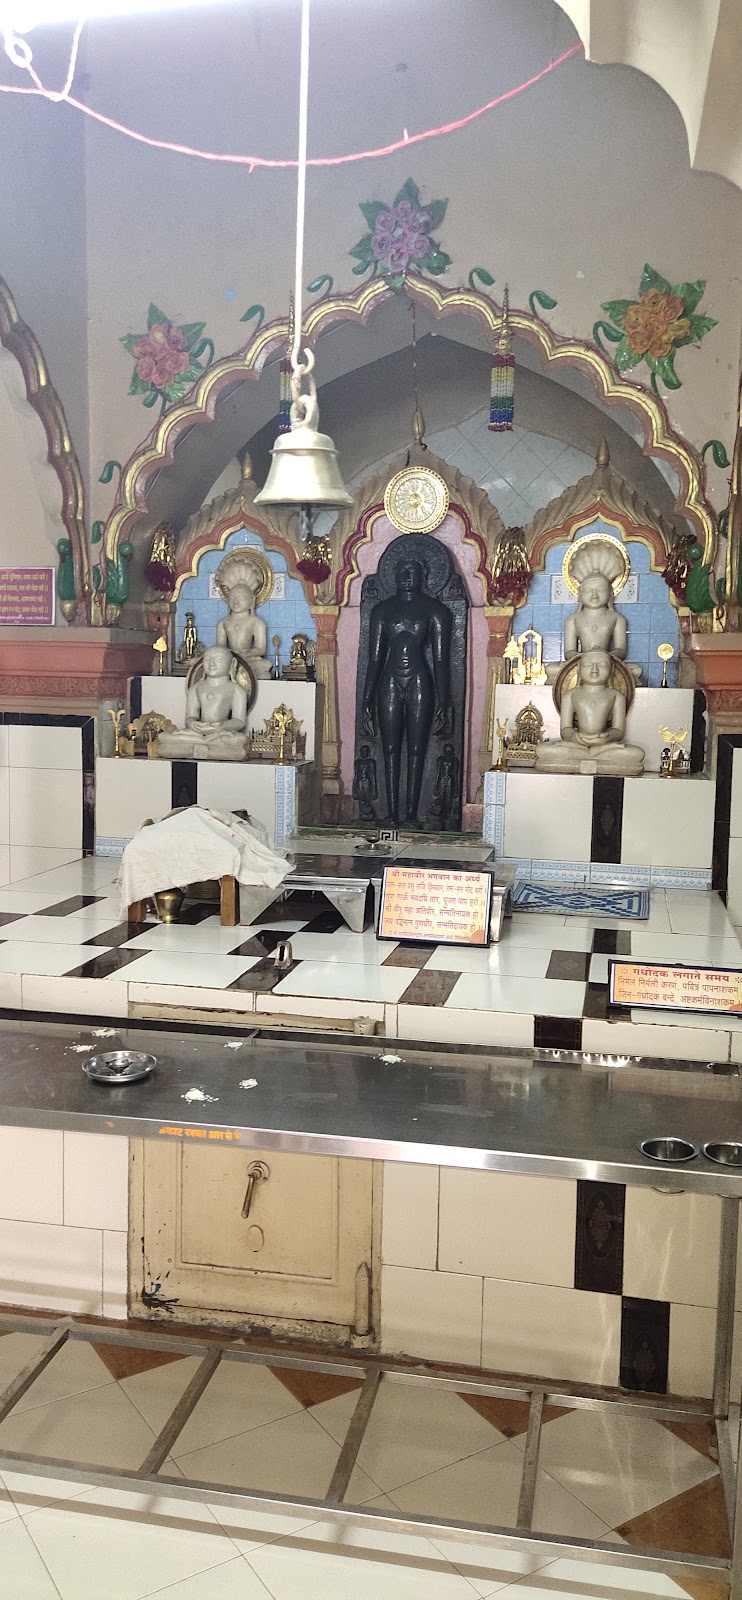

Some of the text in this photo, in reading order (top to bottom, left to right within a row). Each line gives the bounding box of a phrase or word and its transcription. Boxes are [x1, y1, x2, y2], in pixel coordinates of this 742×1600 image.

[402, 871, 425, 879] महावीर
[633, 966, 730, 982] गंधोदक लगाते समय
